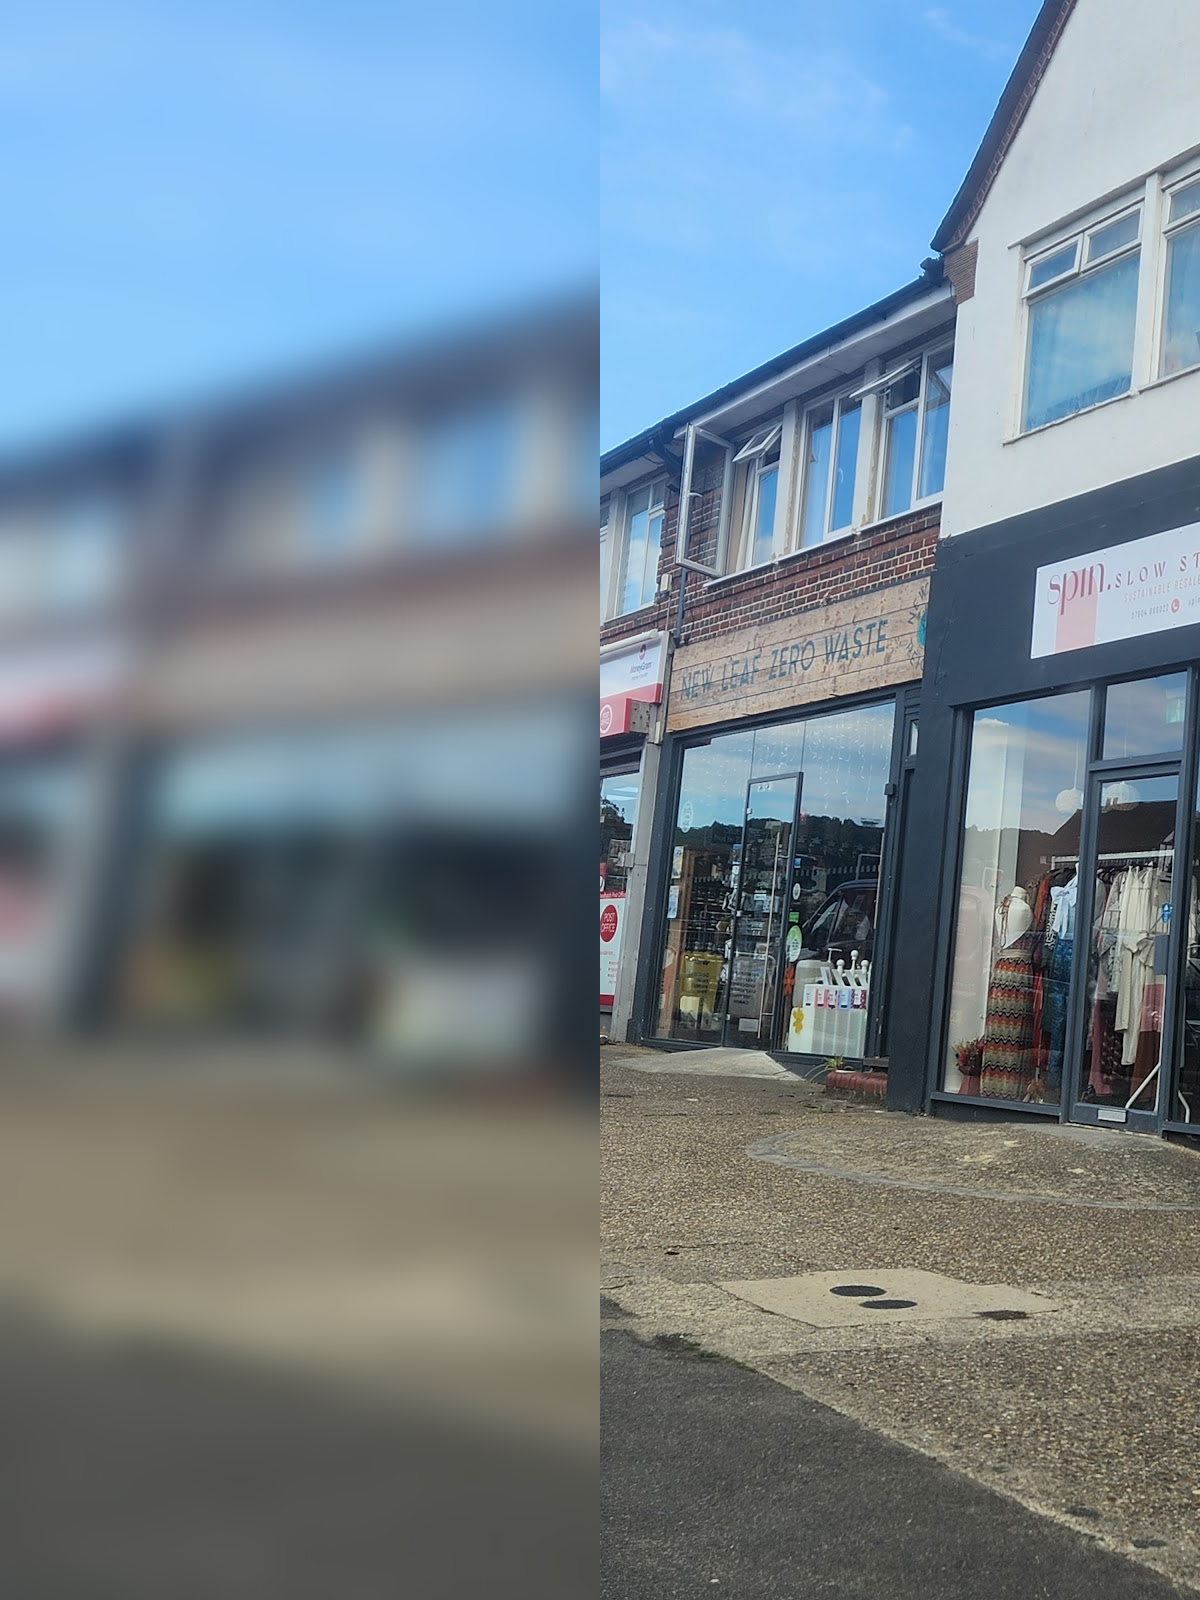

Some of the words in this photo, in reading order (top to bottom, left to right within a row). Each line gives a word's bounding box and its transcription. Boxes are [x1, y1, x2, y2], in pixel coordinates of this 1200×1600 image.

[1115, 561, 1167, 589] SLOW
[1124, 582, 1171, 604] SUSTAINABLE
[681, 663, 714, 700] NEW
[721, 653, 763, 692] LEAF
[768, 640, 815, 681] ZERO
[824, 619, 889, 665] WASTE
[601, 922, 616, 933] OFFICE
[604, 912, 616, 922] POST
